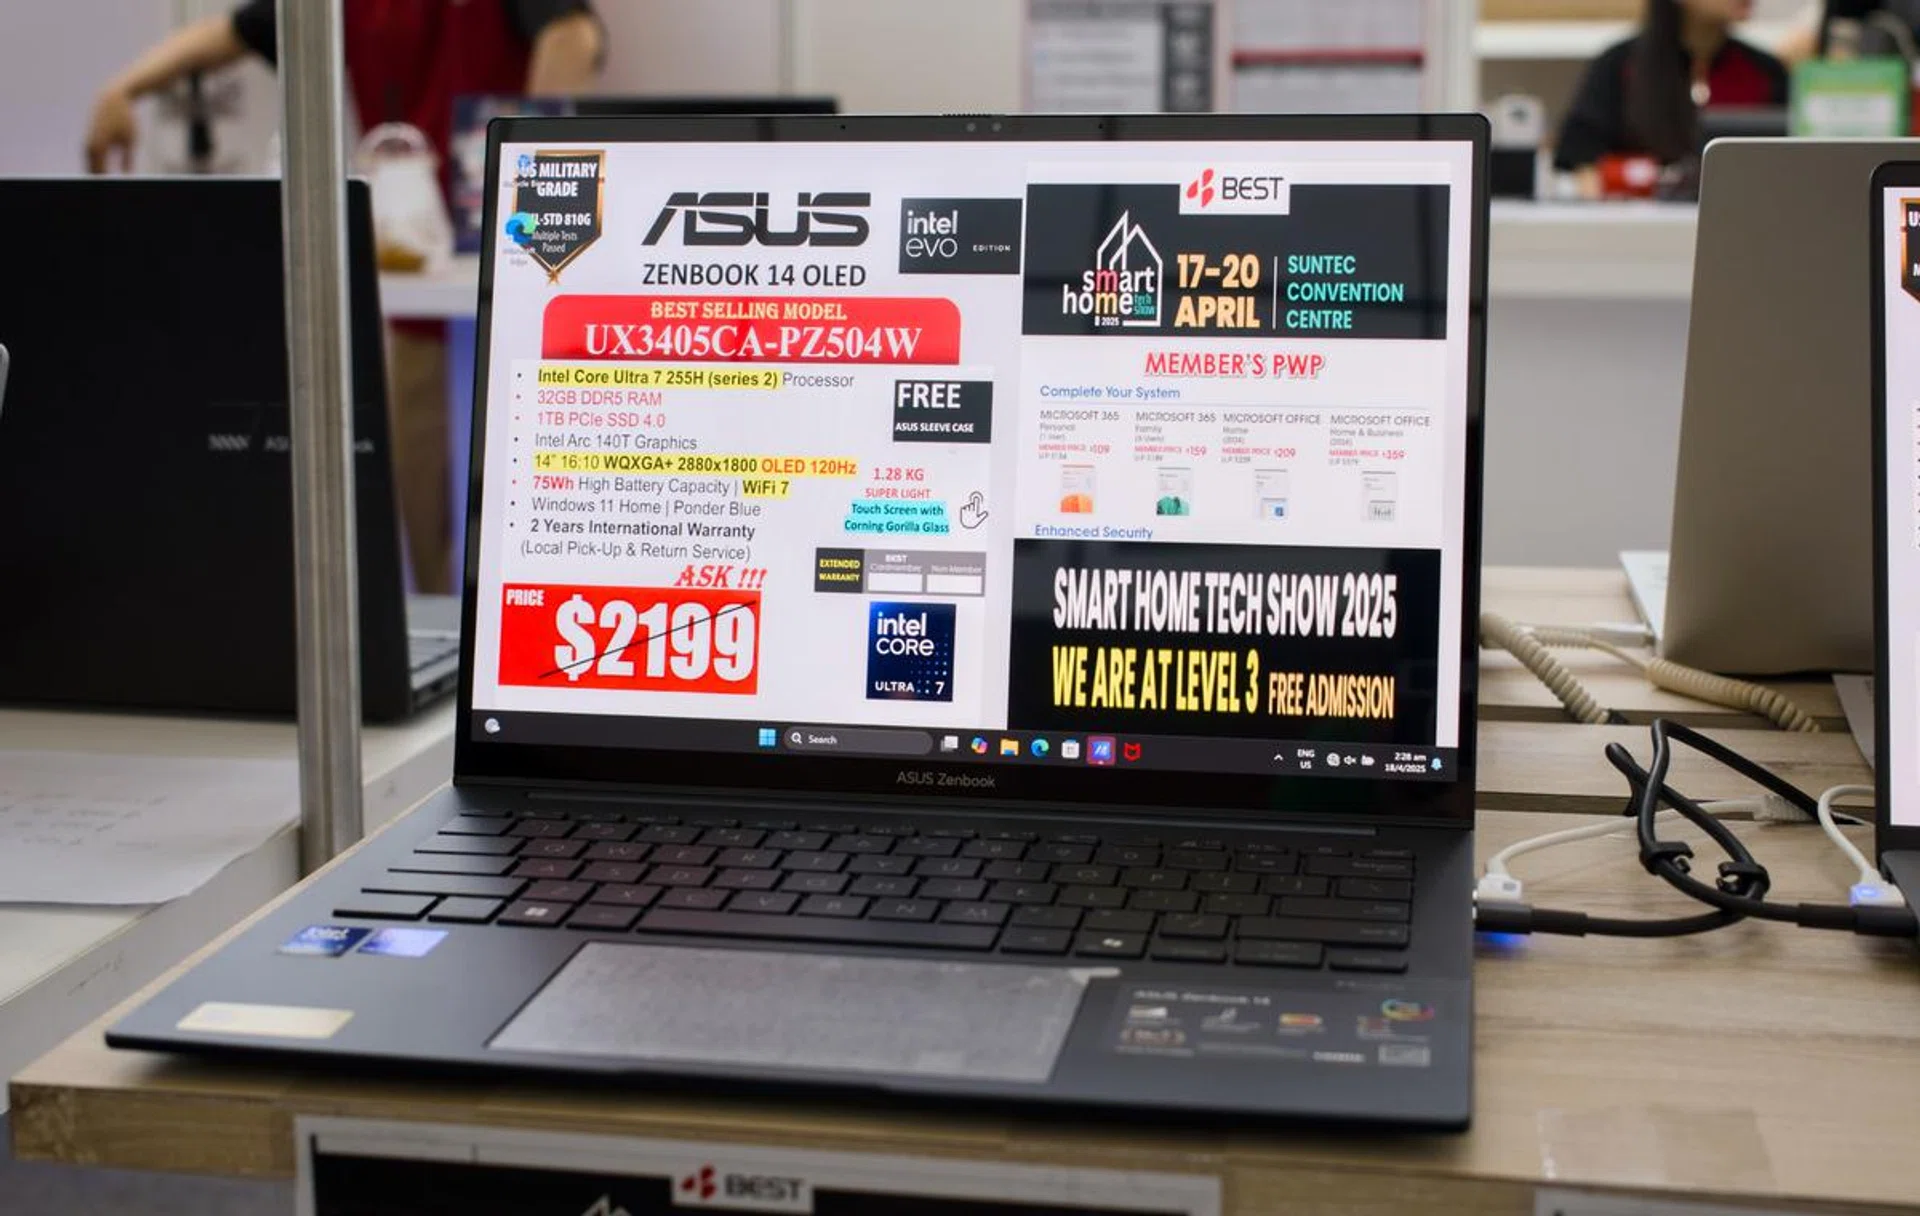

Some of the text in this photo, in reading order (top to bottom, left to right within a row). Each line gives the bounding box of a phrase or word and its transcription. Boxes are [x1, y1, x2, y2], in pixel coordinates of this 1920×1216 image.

[539, 163, 597, 178] MILITARY
[537, 182, 578, 197] GRADE
[1222, 177, 1284, 201] BEST
[564, 213, 591, 226] 810G
[641, 192, 871, 246] ASUS
[907, 209, 958, 235] intel
[1909, 211, 1920, 227] U
[542, 243, 566, 253] Passed
[905, 238, 958, 258] evo
[972, 244, 1012, 252] EDITION
[1177, 253, 1260, 289] 17-20
[1288, 256, 1357, 275] SUNTEC
[642, 263, 866, 287] ZENBOOK 14 OLED
[1082, 267, 1155, 293] smart
[1062, 284, 1133, 315] home
[1134, 293, 1152, 305] tech
[1288, 283, 1403, 303] CONVENTION
[651, 302, 848, 321] BEST SELLING MODEL
[1174, 296, 1260, 330] APRIL
[1101, 317, 1120, 326] 2025
[1287, 310, 1352, 330] CENTRE
[585, 324, 922, 359] UX3405CA-PZ504W
[1145, 352, 1325, 377] MEMBER'S PWP
[538, 370, 854, 388] Intel Core Ultra 7 255H (series 2) Processor
[538, 391, 662, 405] 32GB DDR5 RAM
[897, 383, 961, 409] FREE
[1040, 386, 1180, 401] Complete Your System
[537, 412, 665, 428] 1TB PCIe SSD 4.0
[1040, 410, 1119, 420] MICROSOFT 365
[1136, 412, 1216, 422] MICROSOFT 365
[1223, 413, 1320, 424] MICROSOFT OFFICE
[1331, 415, 1430, 426] MICROSOFT OFFICE
[895, 423, 974, 433] ASUS SLEEVE CASE
[535, 434, 697, 450] Intel Arc 140T Graphics
[562, 456, 599, 468] 16:10
[604, 457, 673, 471] WQXGA+
[678, 458, 757, 472] 2880x1800
[762, 459, 805, 473] OLED
[812, 461, 856, 474] 120Hz
[874, 468, 924, 481] 1.28 KG
[533, 476, 790, 495] 75Wh High Battery Capacity WiFi 7
[865, 488, 931, 499] SUPER LIGHT
[532, 498, 761, 516] Windows 11 Home Ponder Blue
[852, 504, 944, 516] Touch Screen with
[530, 519, 755, 540] 2 Years International Warranty
[844, 520, 949, 534] Corning Gorilla Glass
[1035, 525, 1153, 539] Enhanced Security
[521, 541, 751, 561] (Local Pick-Up & Return Service)
[819, 559, 860, 569] EXTENDED
[674, 565, 768, 588] ASK !!!
[819, 573, 860, 582] WARRANTY
[506, 589, 544, 606] PRICE
[1053, 567, 1397, 638] SMART HOME TECH SHOW 2025
[877, 612, 927, 636] intel
[554, 594, 756, 682] $2199
[875, 681, 945, 695] ULTRA 7
[1052, 646, 1394, 719] WE ARE AT LEVEL 3 FREE ADMISSION
[808, 735, 837, 744] Search
[1298, 749, 1315, 758] ENG
[1300, 761, 1312, 769] US
[897, 772, 995, 788] ASUS Zenbook
[725, 1174, 804, 1199] BEST
